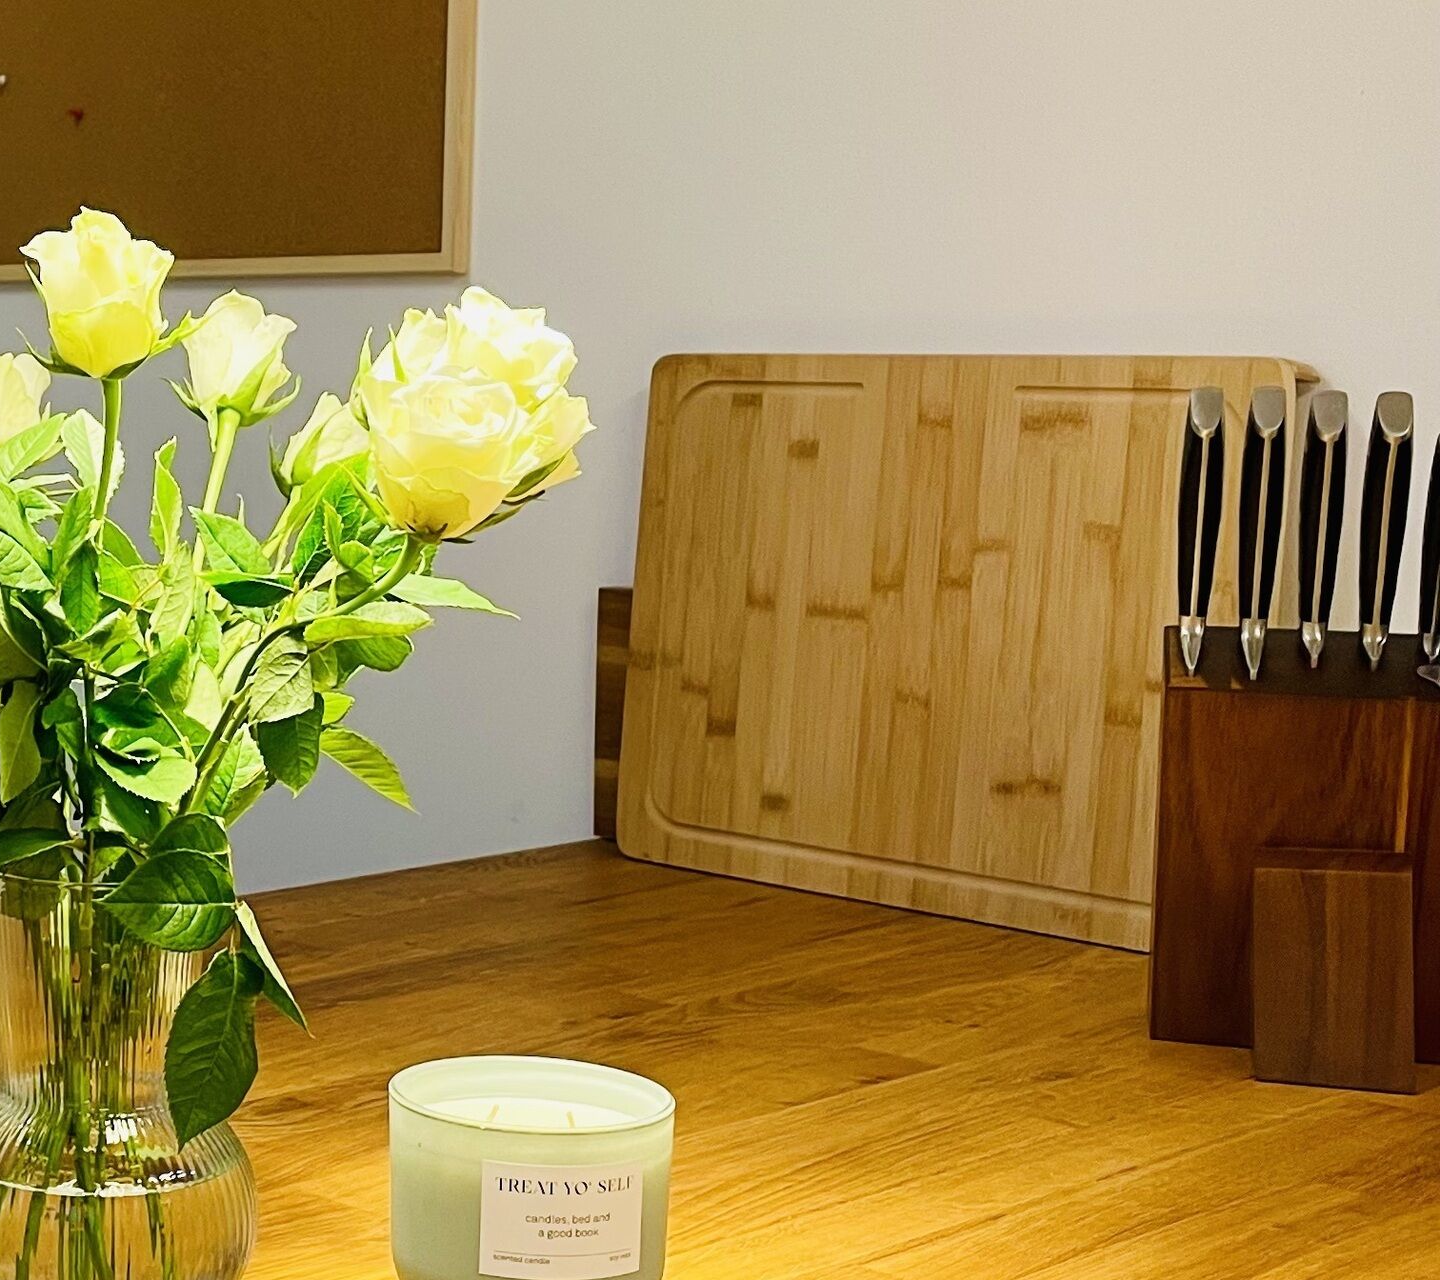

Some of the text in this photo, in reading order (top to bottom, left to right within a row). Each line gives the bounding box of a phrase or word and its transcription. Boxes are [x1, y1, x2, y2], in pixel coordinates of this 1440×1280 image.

[495, 1175, 634, 1196] TREAT YO' SELF
[572, 1214, 591, 1225] bed
[593, 1212, 611, 1223] and
[538, 1228, 599, 1240] a good book
